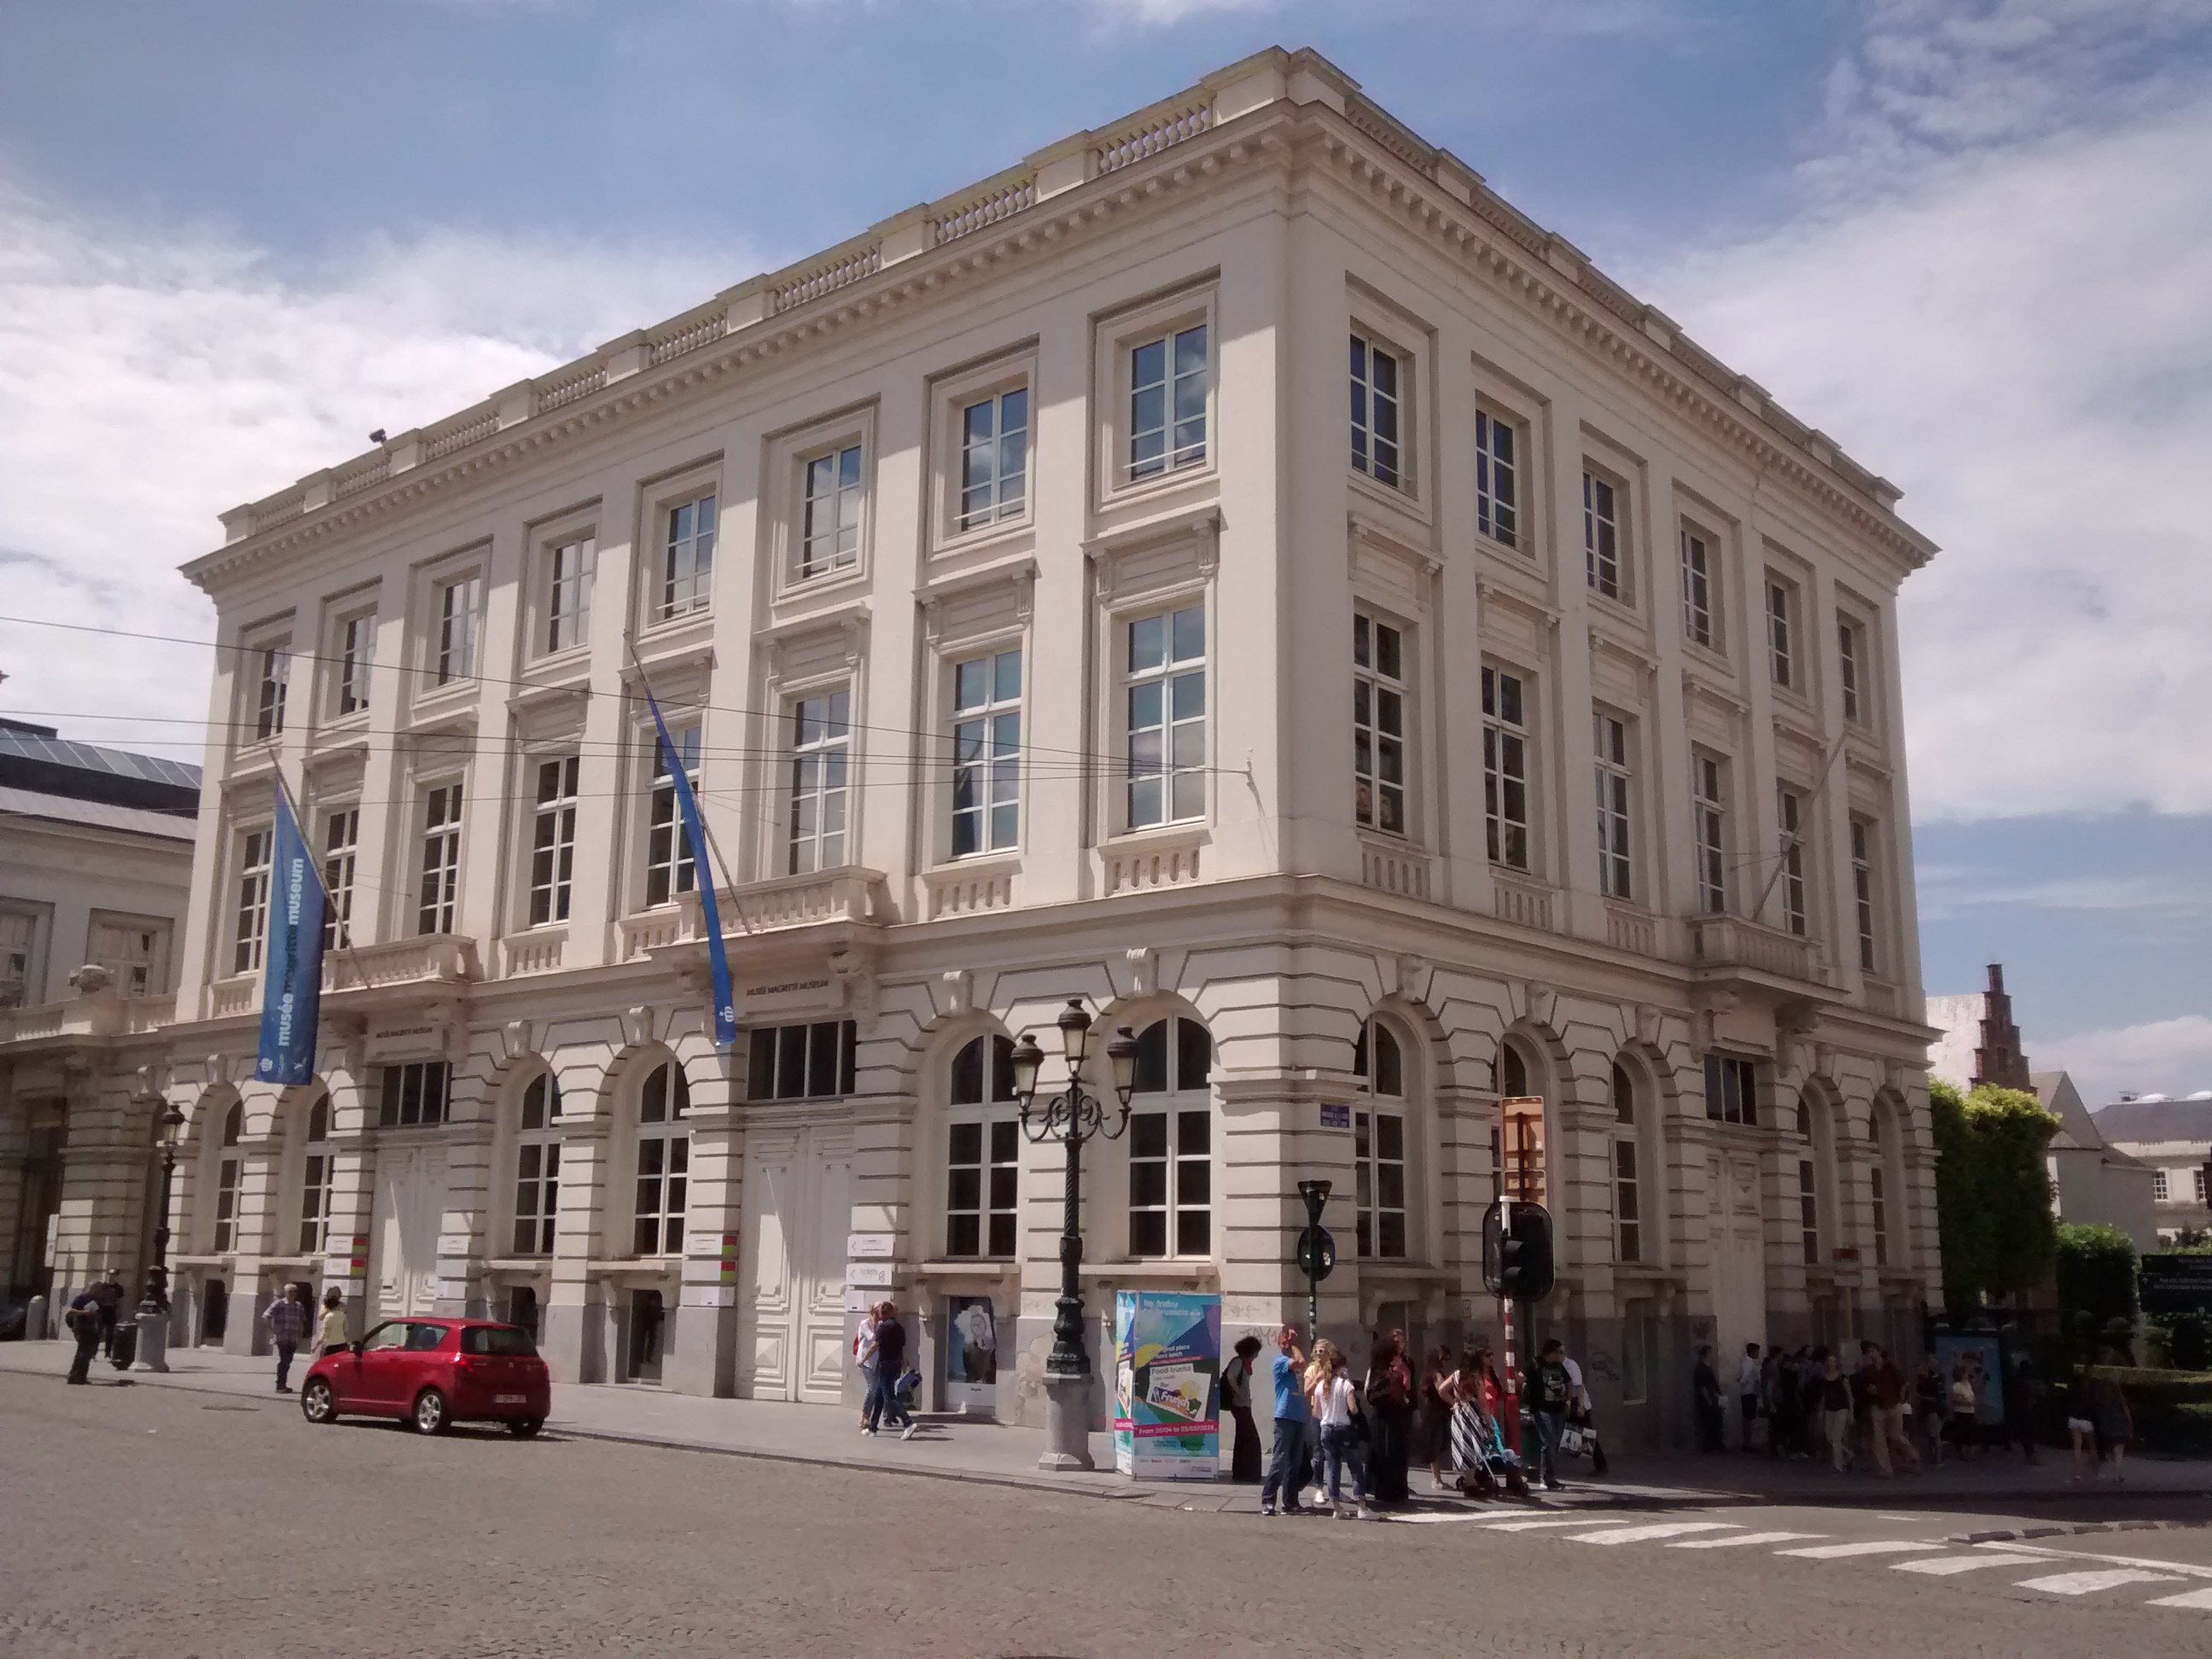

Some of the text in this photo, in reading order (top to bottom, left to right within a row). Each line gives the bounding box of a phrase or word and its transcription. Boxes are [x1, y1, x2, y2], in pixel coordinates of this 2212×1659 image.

[276, 993, 294, 1046] musée
[288, 858, 305, 925] museum
[800, 981, 829, 989] MUSEUM
